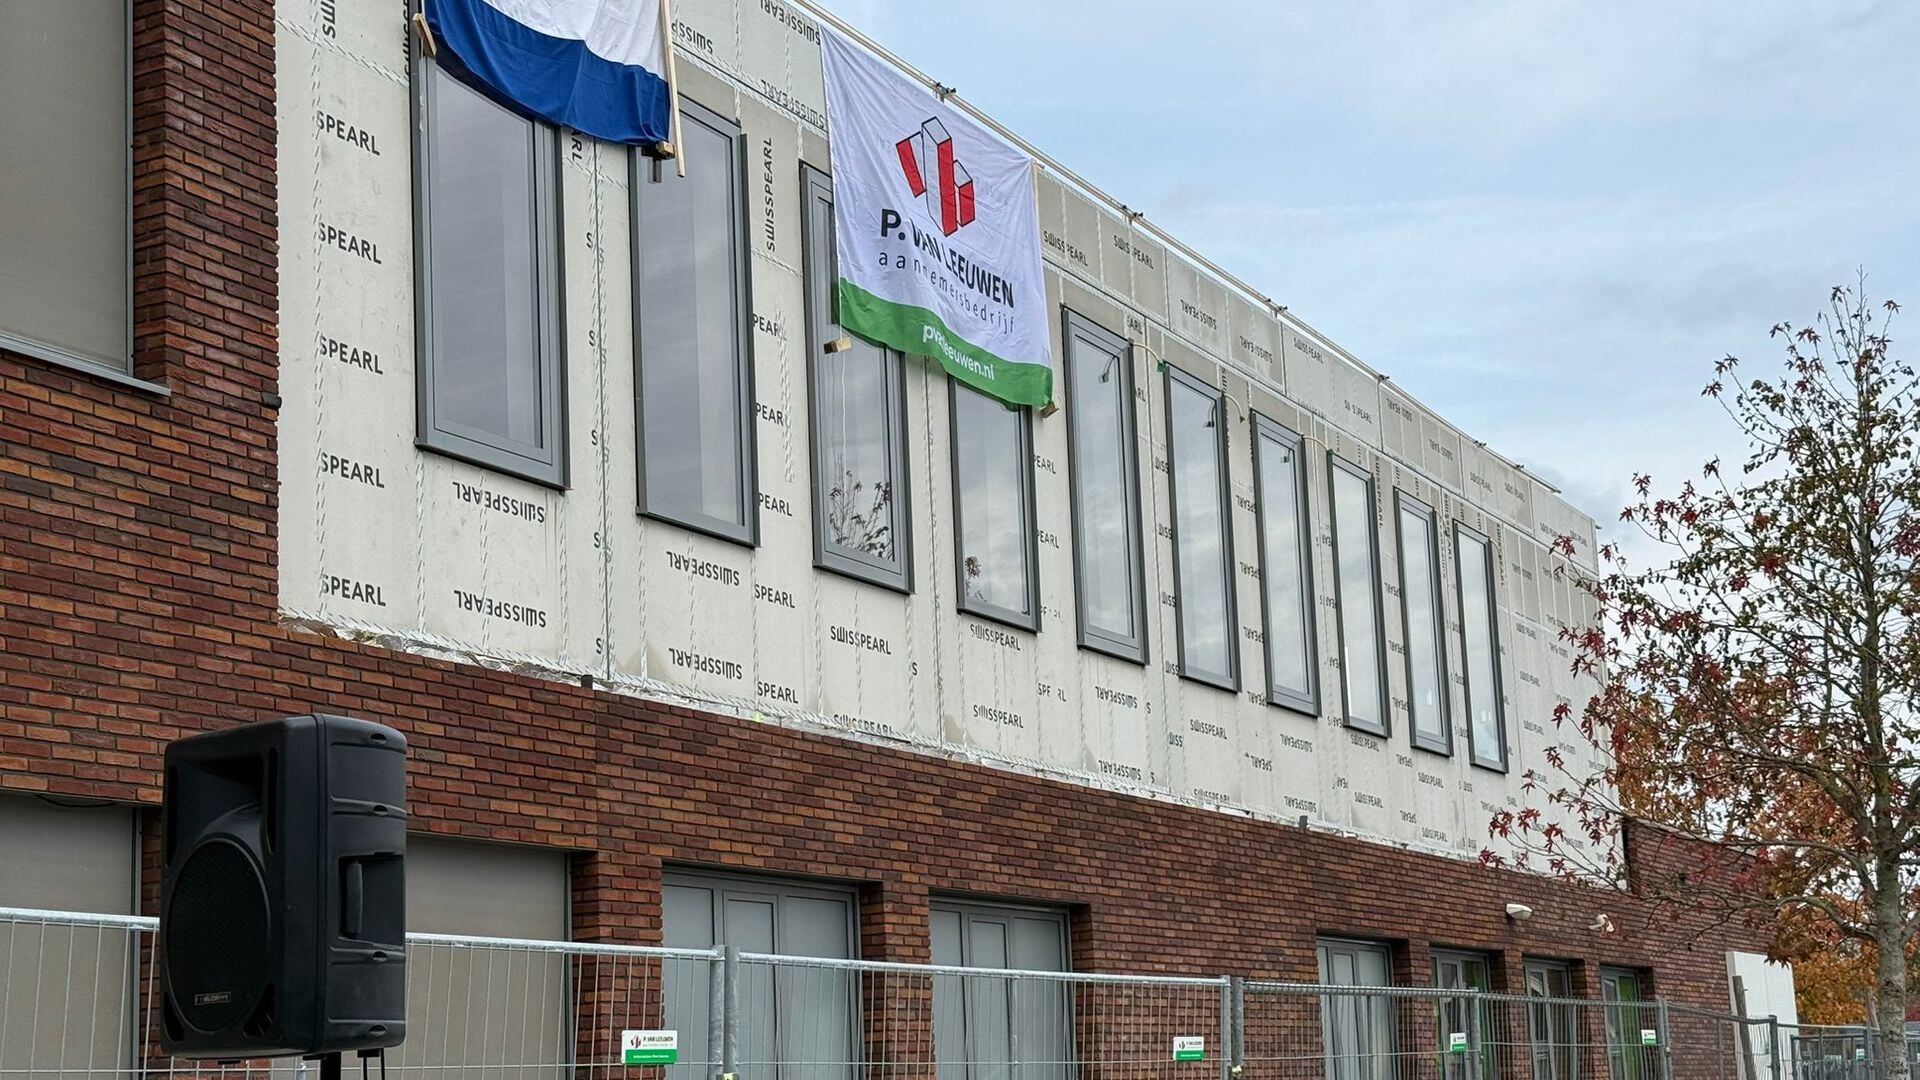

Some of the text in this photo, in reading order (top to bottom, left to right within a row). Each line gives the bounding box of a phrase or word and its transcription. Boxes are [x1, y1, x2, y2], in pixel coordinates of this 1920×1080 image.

[317, 110, 380, 156] SPEARL
[763, 136, 775, 252] SWISSPEARL
[318, 222, 382, 265] SPEARL
[881, 208, 1014, 308] P. VAN LEEUWEN
[320, 336, 383, 376] SPEARL
[321, 452, 386, 488] SPEARL
[453, 482, 545, 524] SWISSPEARL
[666, 551, 740, 586] SWISSPEARL
[322, 574, 386, 607] SPEARL
[754, 584, 796, 608] SPEARL
[454, 590, 547, 628] SWISSPEARL
[830, 625, 892, 654] SWISSPEARL
[970, 624, 1021, 651] SWISSPEARL
[668, 648, 742, 680] SWISSPEARL
[758, 681, 798, 704] SPEARL
[974, 704, 1024, 728] SWISSPEARL
